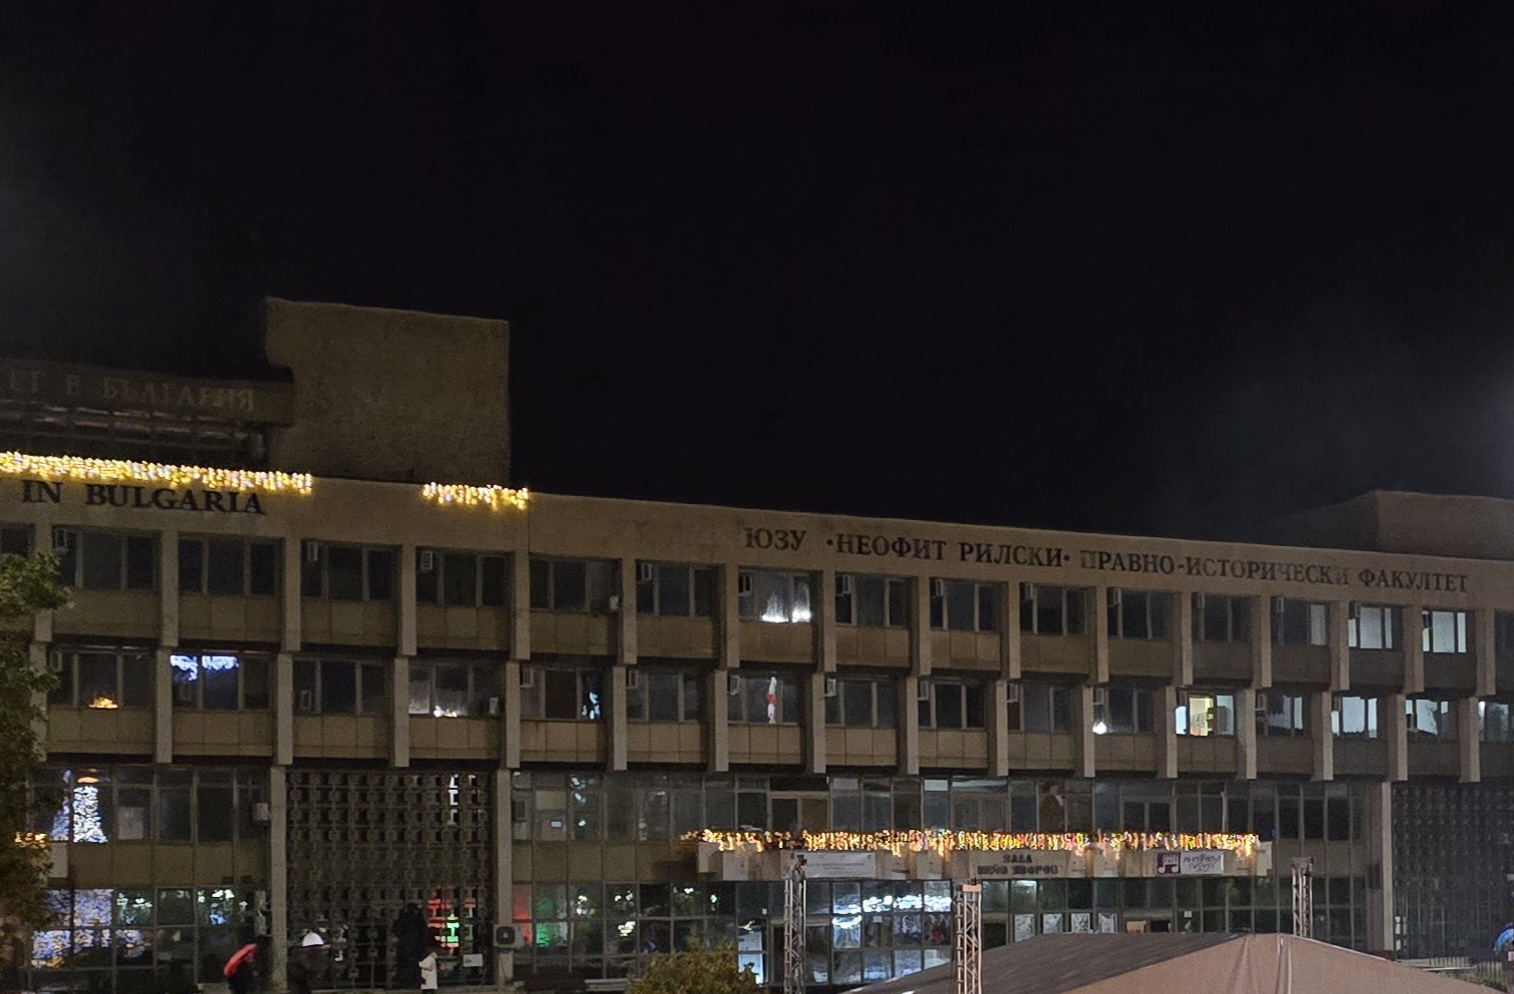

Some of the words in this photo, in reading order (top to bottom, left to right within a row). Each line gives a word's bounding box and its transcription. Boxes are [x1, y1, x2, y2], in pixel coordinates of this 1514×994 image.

[22, 479, 63, 504] IN
[85, 483, 266, 515] BULGARIA
[743, 527, 808, 552] ЮЗУ
[1357, 567, 1469, 594] ФАКУЛТЕТ
